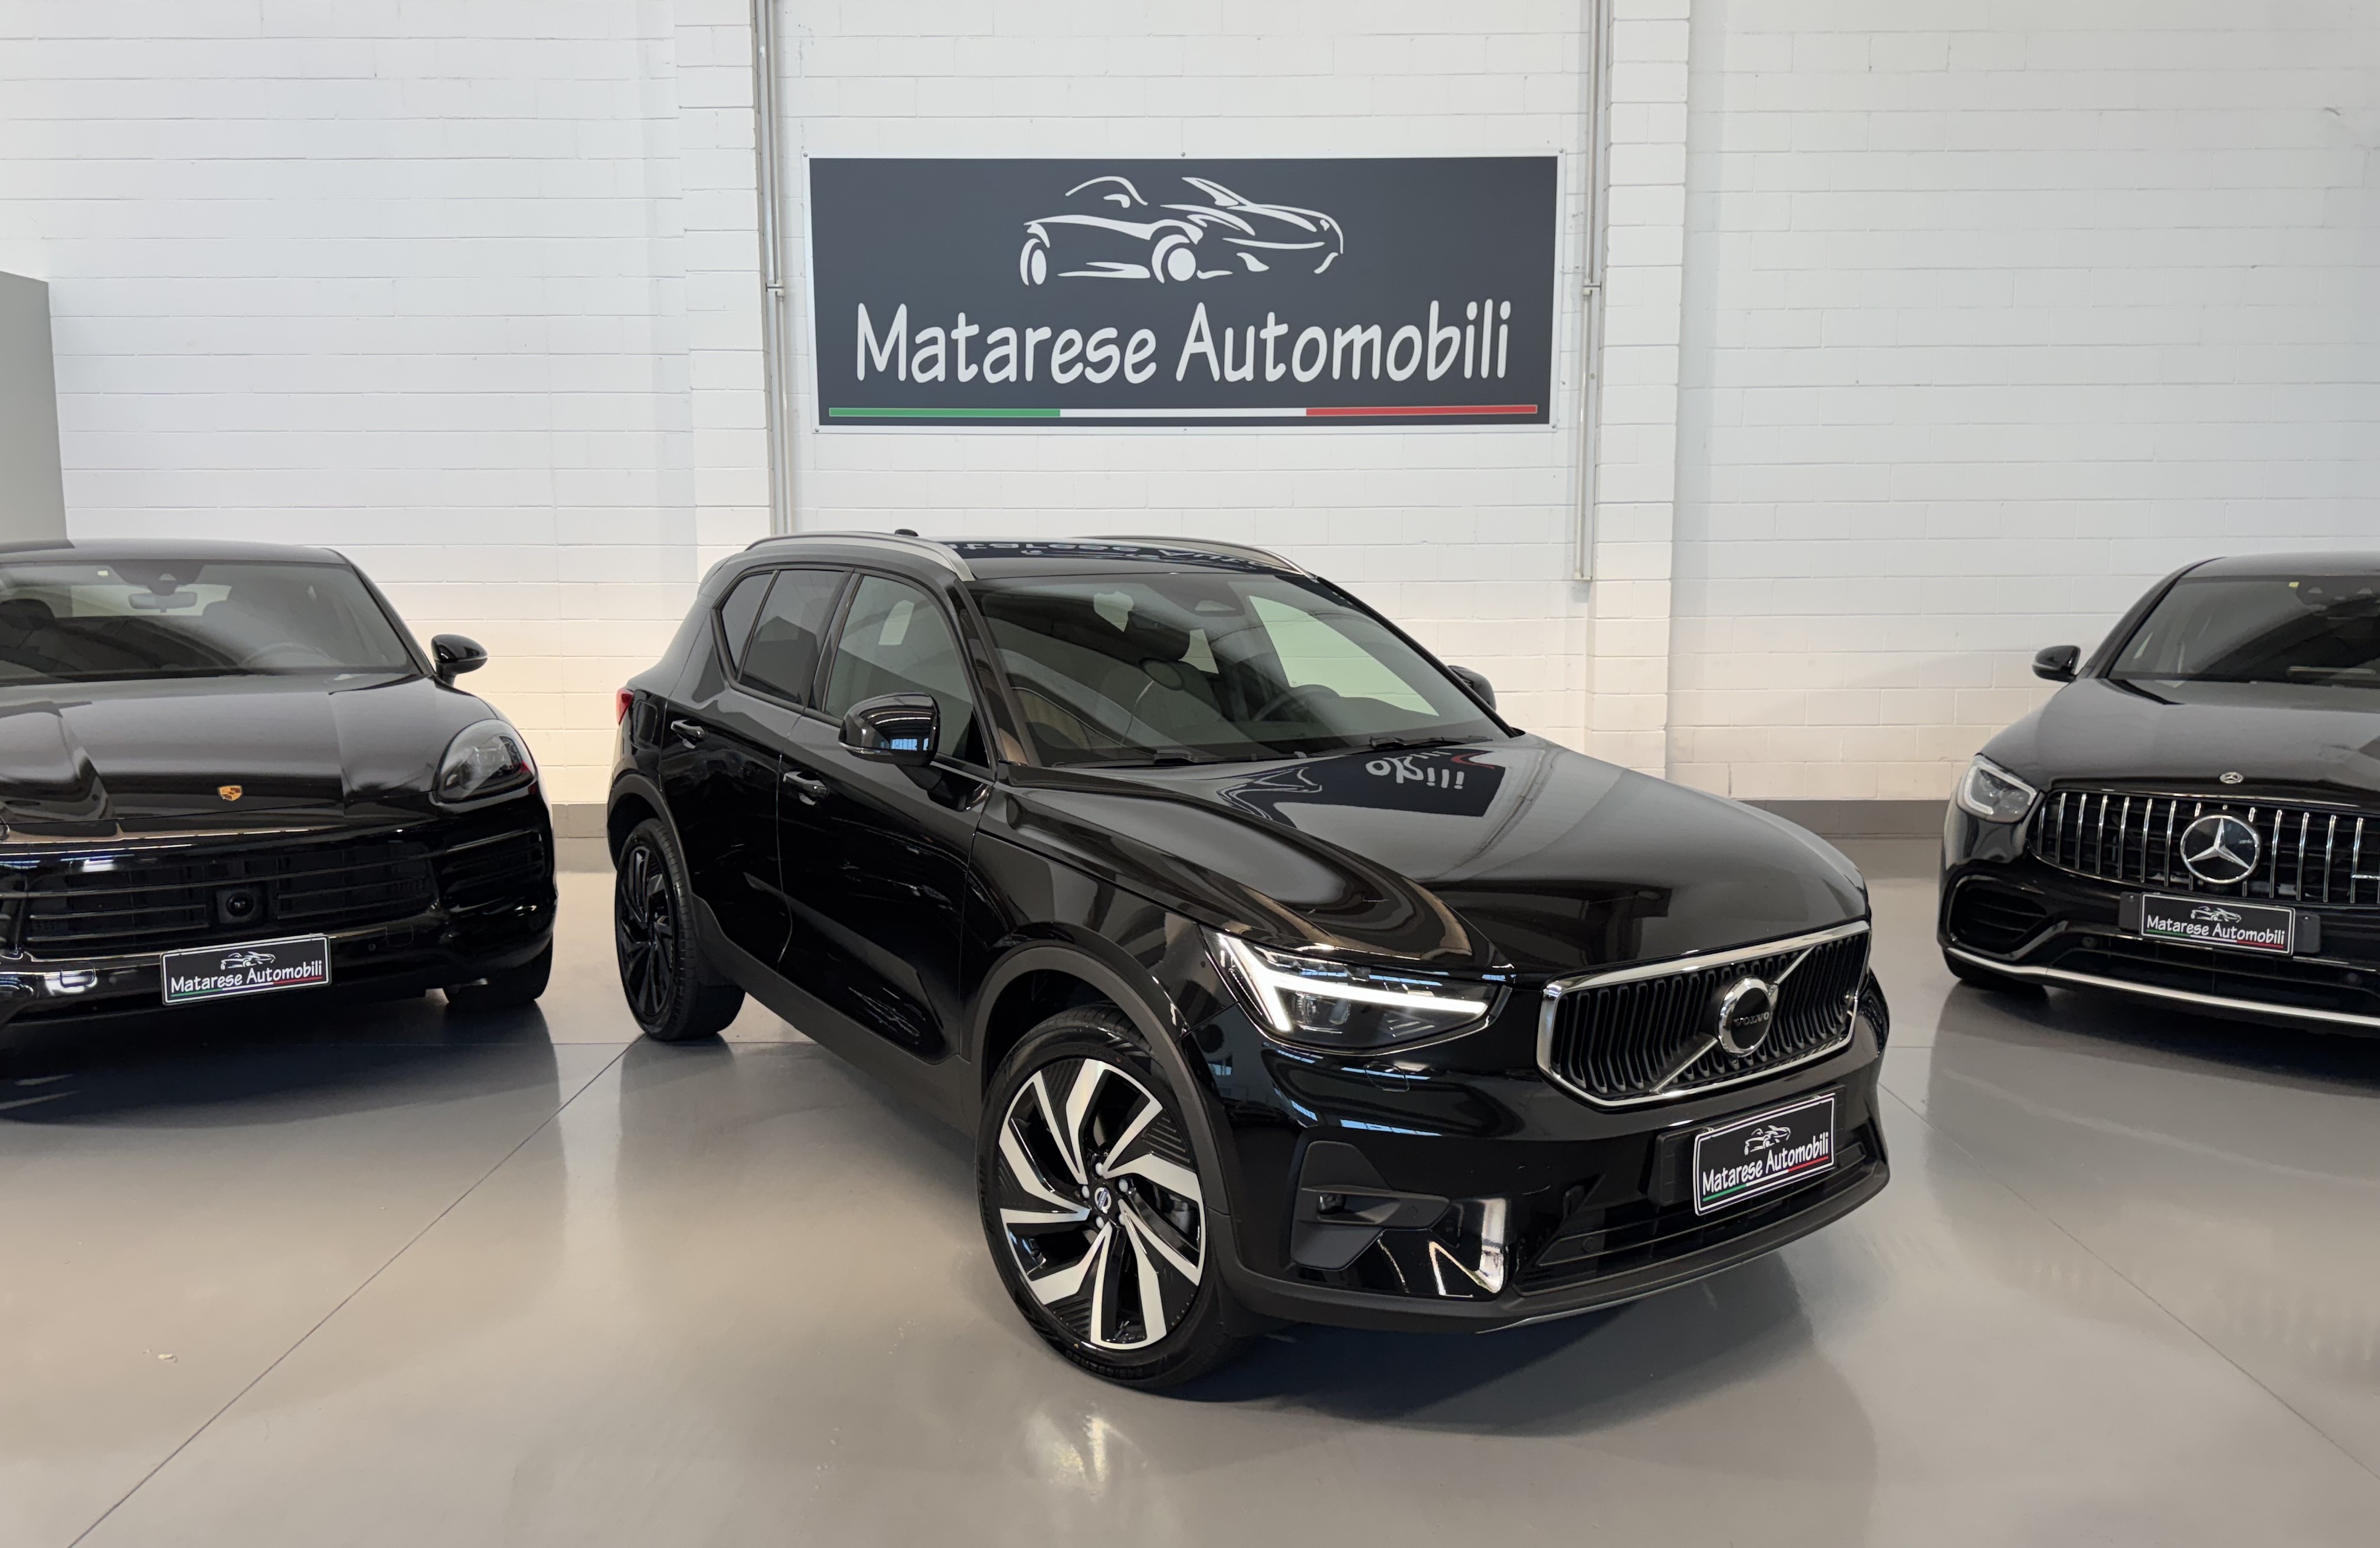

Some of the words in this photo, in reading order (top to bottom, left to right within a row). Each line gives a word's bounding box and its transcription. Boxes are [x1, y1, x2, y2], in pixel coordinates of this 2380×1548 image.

[857, 302, 1156, 384] Matarese
[1176, 299, 1511, 383] Automobili
[2146, 915, 2209, 936] Matarese
[2212, 922, 2285, 945] Automobili
[171, 974, 243, 994] Matarese
[246, 960, 322, 984] Automobili
[1732, 1011, 1770, 1027] VOLVO
[1702, 1160, 1763, 1196] Matarese
[1765, 1131, 1829, 1174] Automobili
